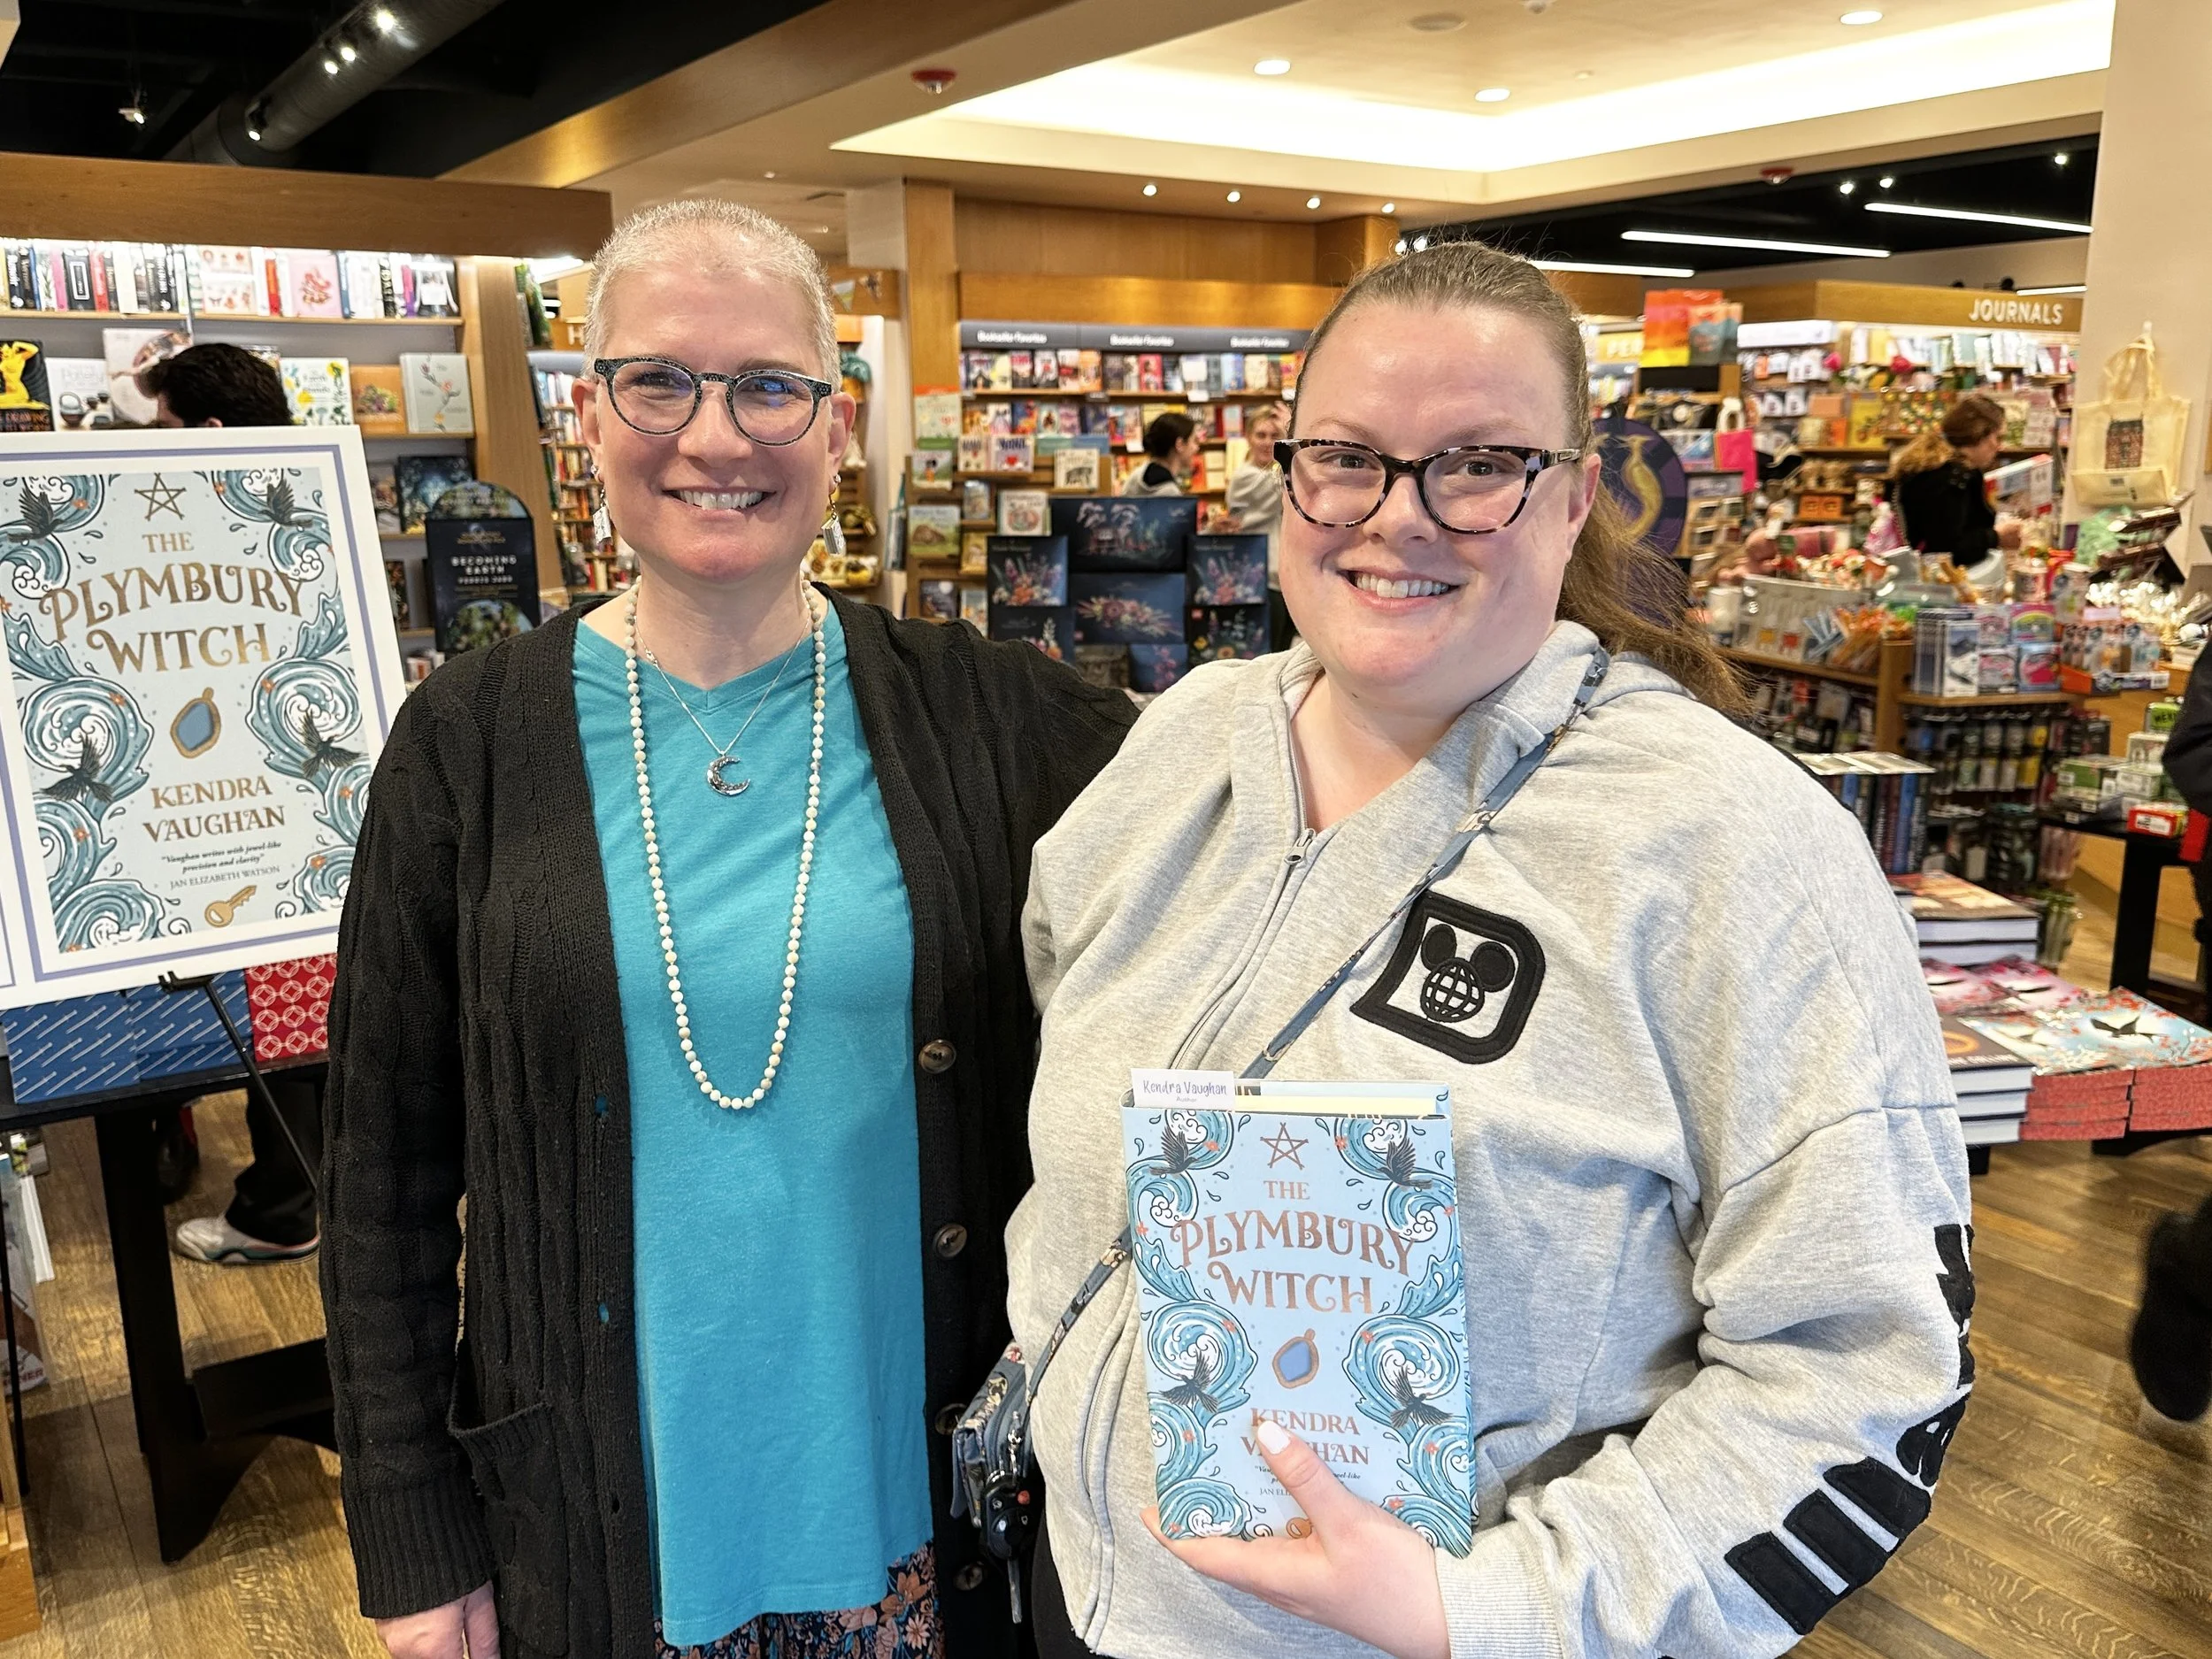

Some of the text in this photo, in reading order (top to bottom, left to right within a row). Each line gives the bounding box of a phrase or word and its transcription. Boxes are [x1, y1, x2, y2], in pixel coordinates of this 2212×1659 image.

[1969, 298, 2063, 325] JOURNALS
[142, 532, 194, 553] THE
[451, 555, 517, 566] BECOMING
[465, 565, 505, 575] EARTH
[39, 562, 304, 641] PLYMBURY
[87, 623, 271, 675] WITCH
[151, 775, 273, 810] KENDRA
[142, 805, 285, 842] VAUGHAN
[170, 866, 280, 890] JAN ELIZABETH WATSON
[182, 863, 218, 874] precision
[219, 858, 234, 867] and
[1143, 1080, 1227, 1097] Kendra Vaughan
[1263, 1179, 1310, 1201] THE
[1170, 1210, 1418, 1277] PLYMBURY
[1207, 1261, 1374, 1315] WITCH
[1250, 1408, 1361, 1436] KENDRA
